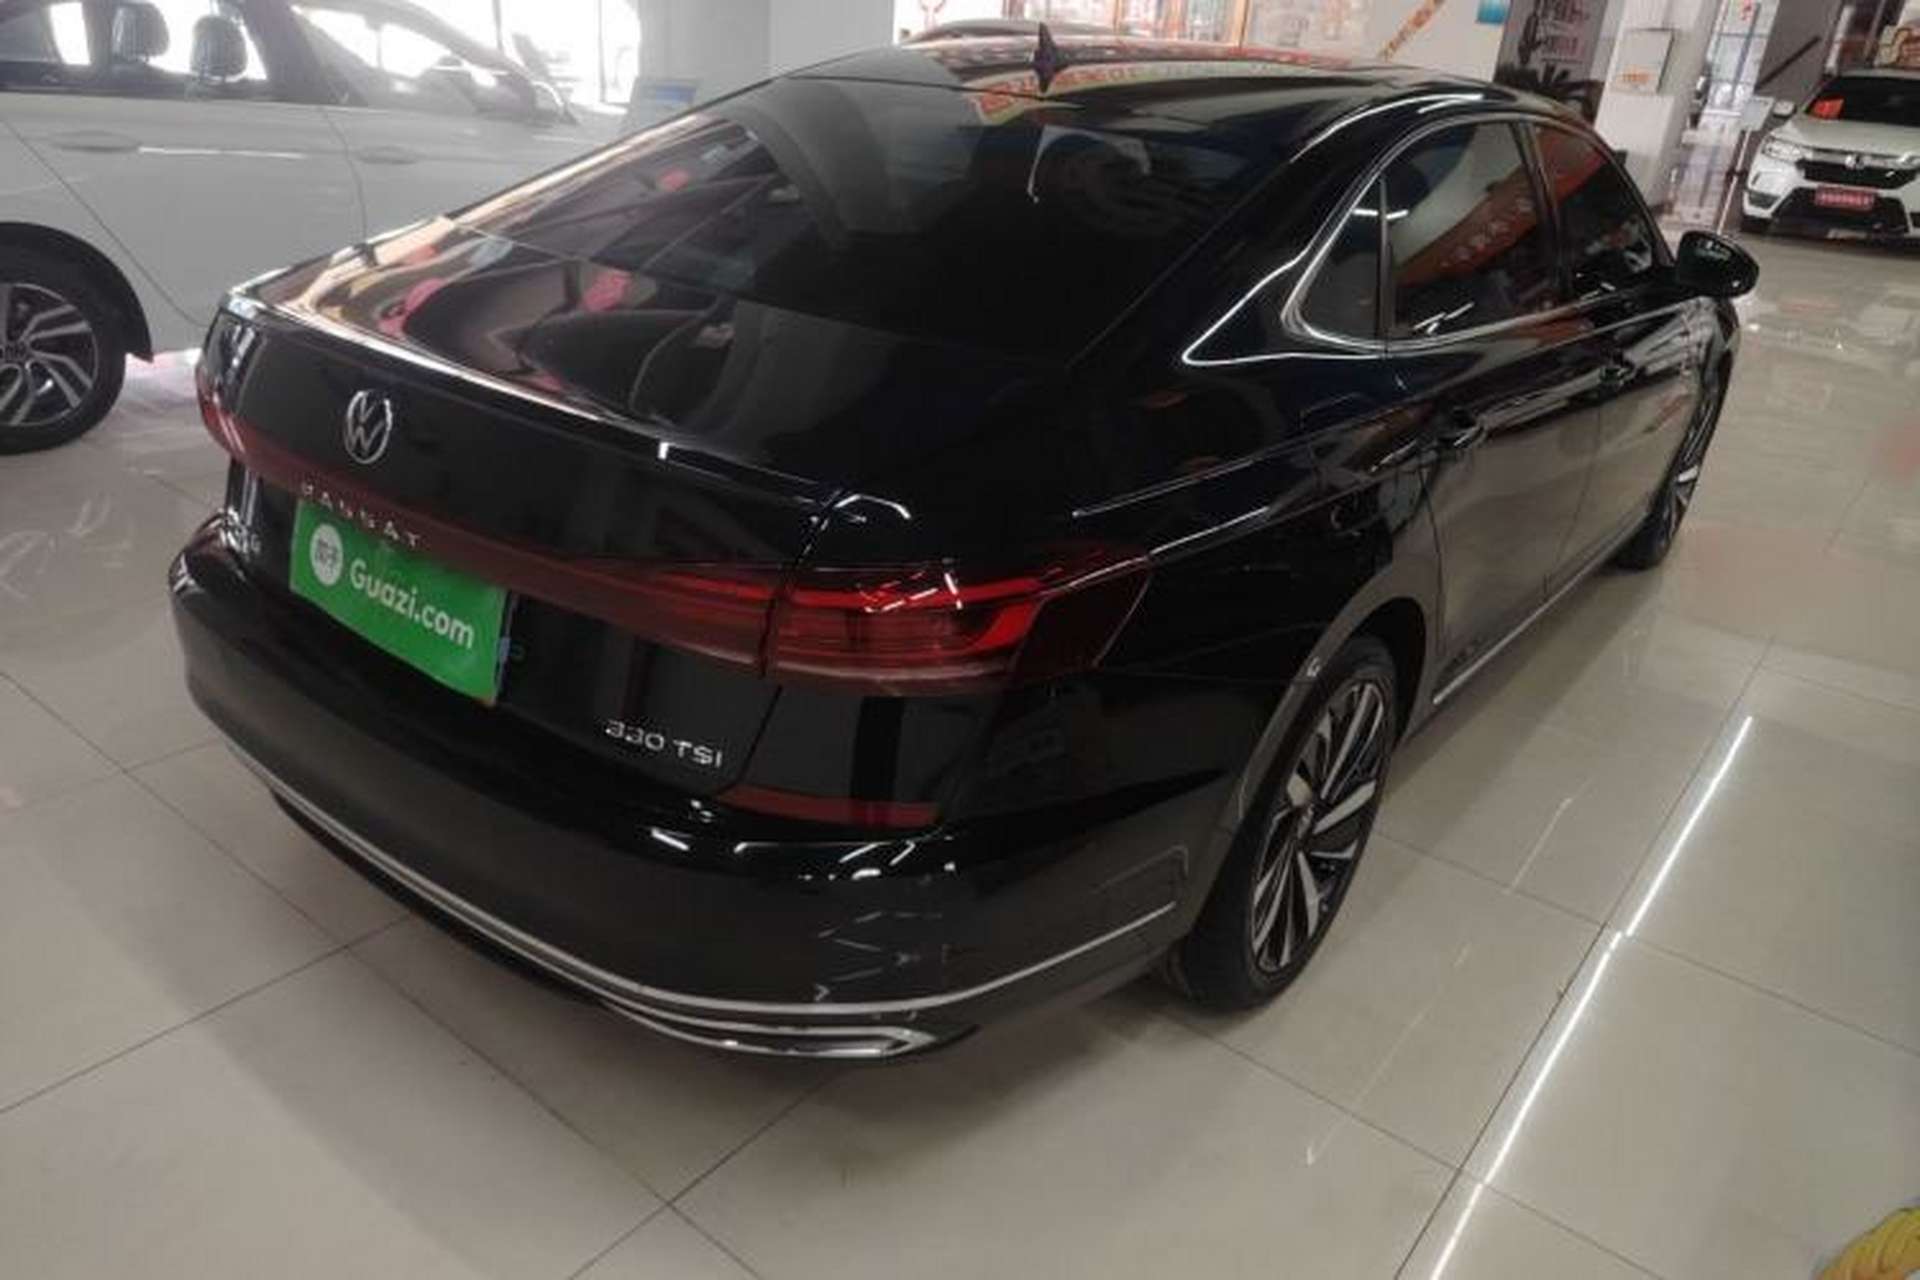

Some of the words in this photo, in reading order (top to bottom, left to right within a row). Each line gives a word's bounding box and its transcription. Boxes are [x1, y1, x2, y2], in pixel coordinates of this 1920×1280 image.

[350, 558, 475, 649] Guazi.com
[605, 720, 664, 750] 330
[673, 740, 722, 768] TSI
